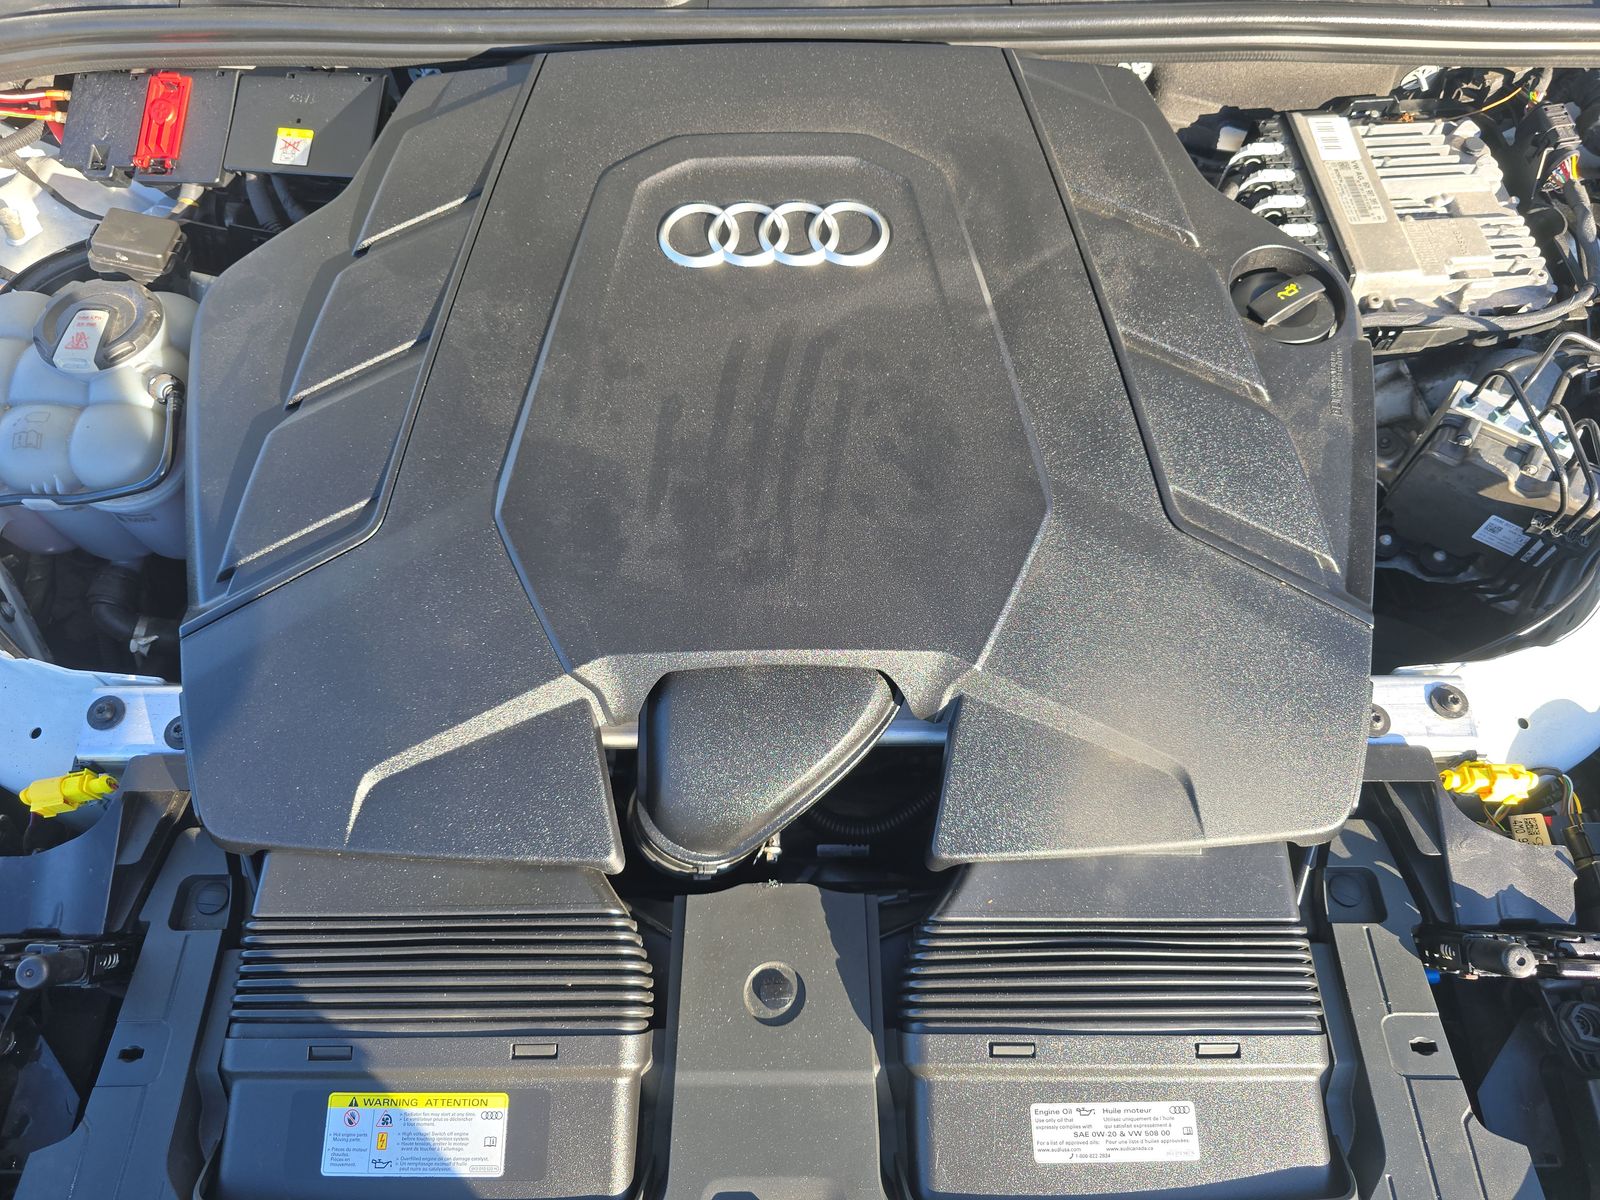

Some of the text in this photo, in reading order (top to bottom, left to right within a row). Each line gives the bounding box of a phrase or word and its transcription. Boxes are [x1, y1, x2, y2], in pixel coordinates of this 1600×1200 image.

[1350, 160, 1364, 180] VW AG
[363, 1098, 488, 1107] WARNING ATTENTION
